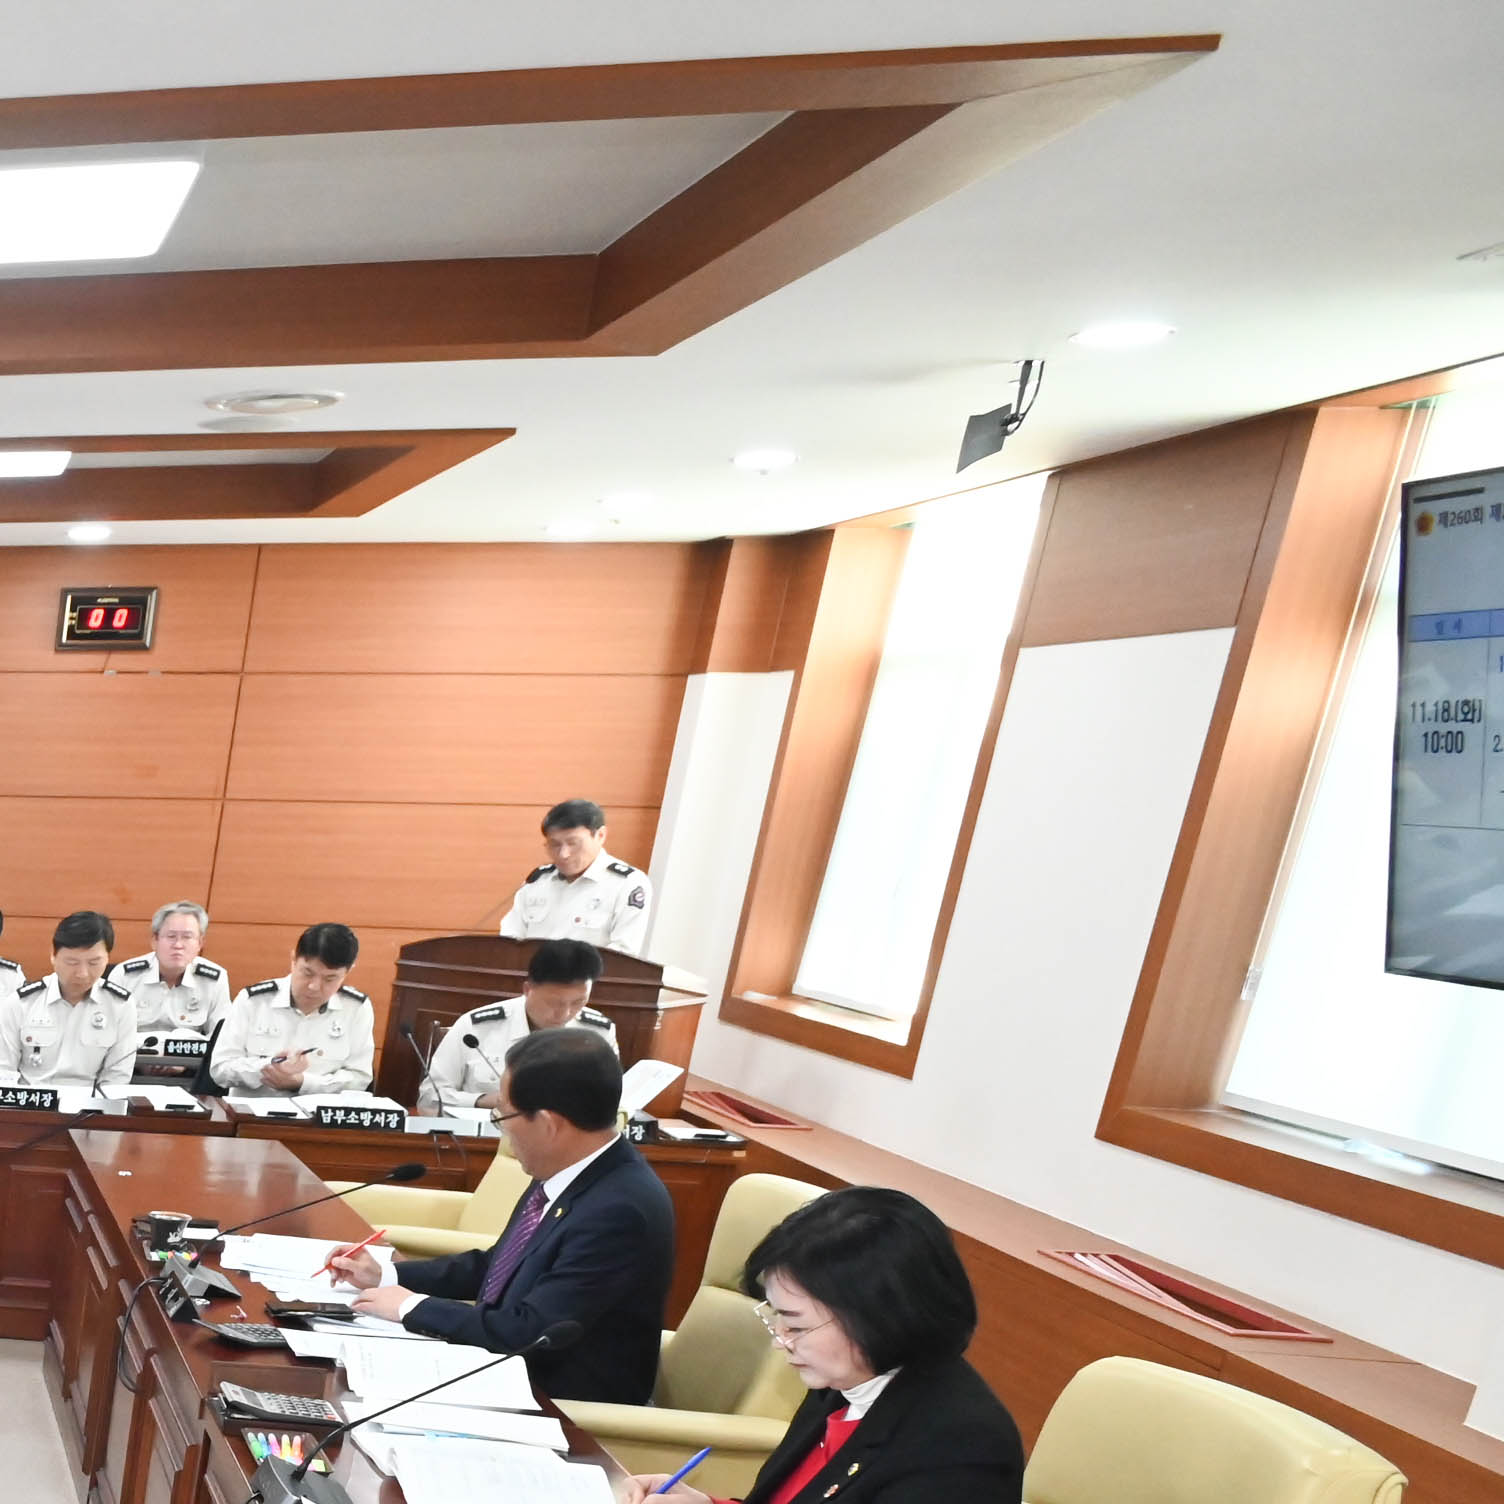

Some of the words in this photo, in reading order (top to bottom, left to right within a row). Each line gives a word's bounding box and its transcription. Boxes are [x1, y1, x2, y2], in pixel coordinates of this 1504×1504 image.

[1490, 503, 1504, 523] 제
[1422, 730, 1465, 754] 10:00
[320, 1108, 400, 1129] 남부소방서장
